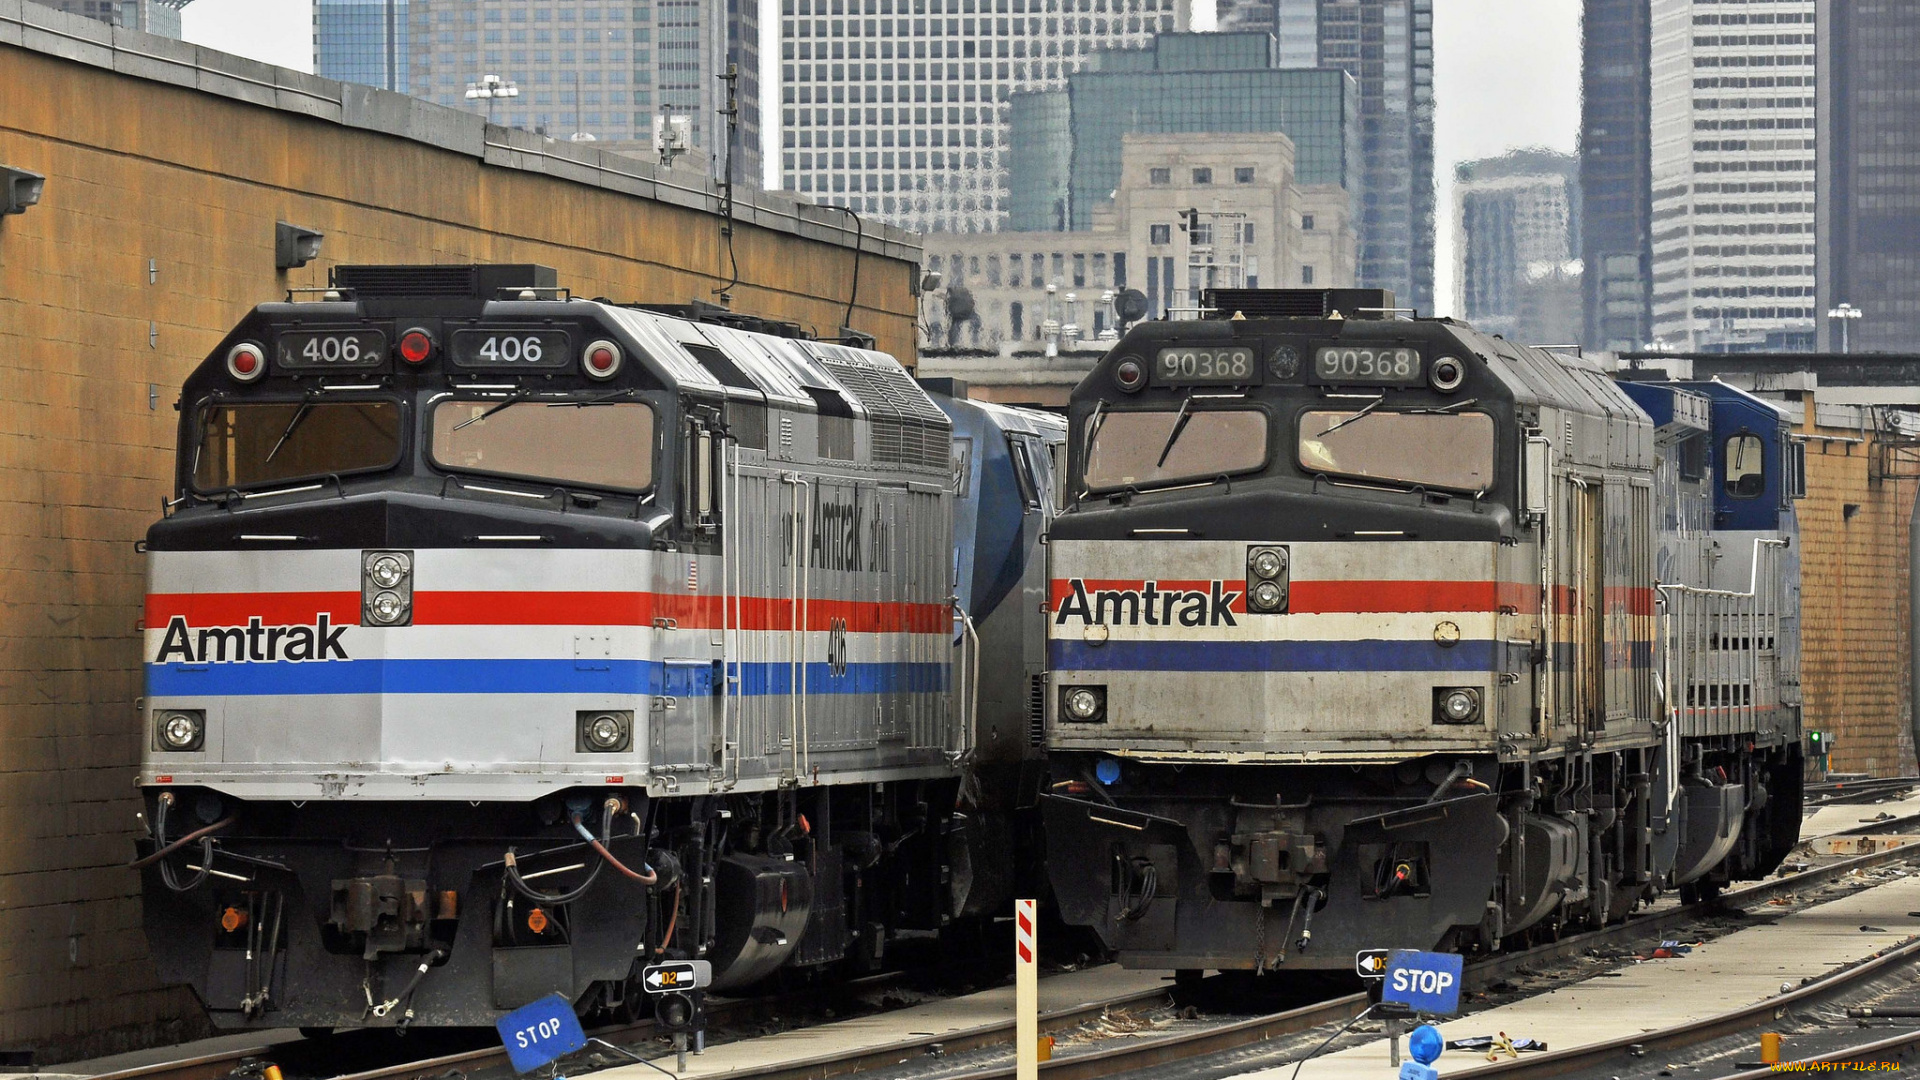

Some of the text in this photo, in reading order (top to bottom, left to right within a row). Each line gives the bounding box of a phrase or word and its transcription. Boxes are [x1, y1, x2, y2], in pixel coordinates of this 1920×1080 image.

[302, 336, 360, 362] 406
[479, 336, 542, 362] 406
[1164, 352, 1247, 377] 90368
[1323, 350, 1410, 376] 90368
[810, 477, 863, 573] Amtrak
[1055, 579, 1238, 627] Amtrak
[154, 614, 350, 664] Amtrak
[828, 617, 846, 677] 406
[661, 972, 677, 984] D2
[1392, 968, 1453, 995] STOP
[516, 1017, 561, 1049] STOP
